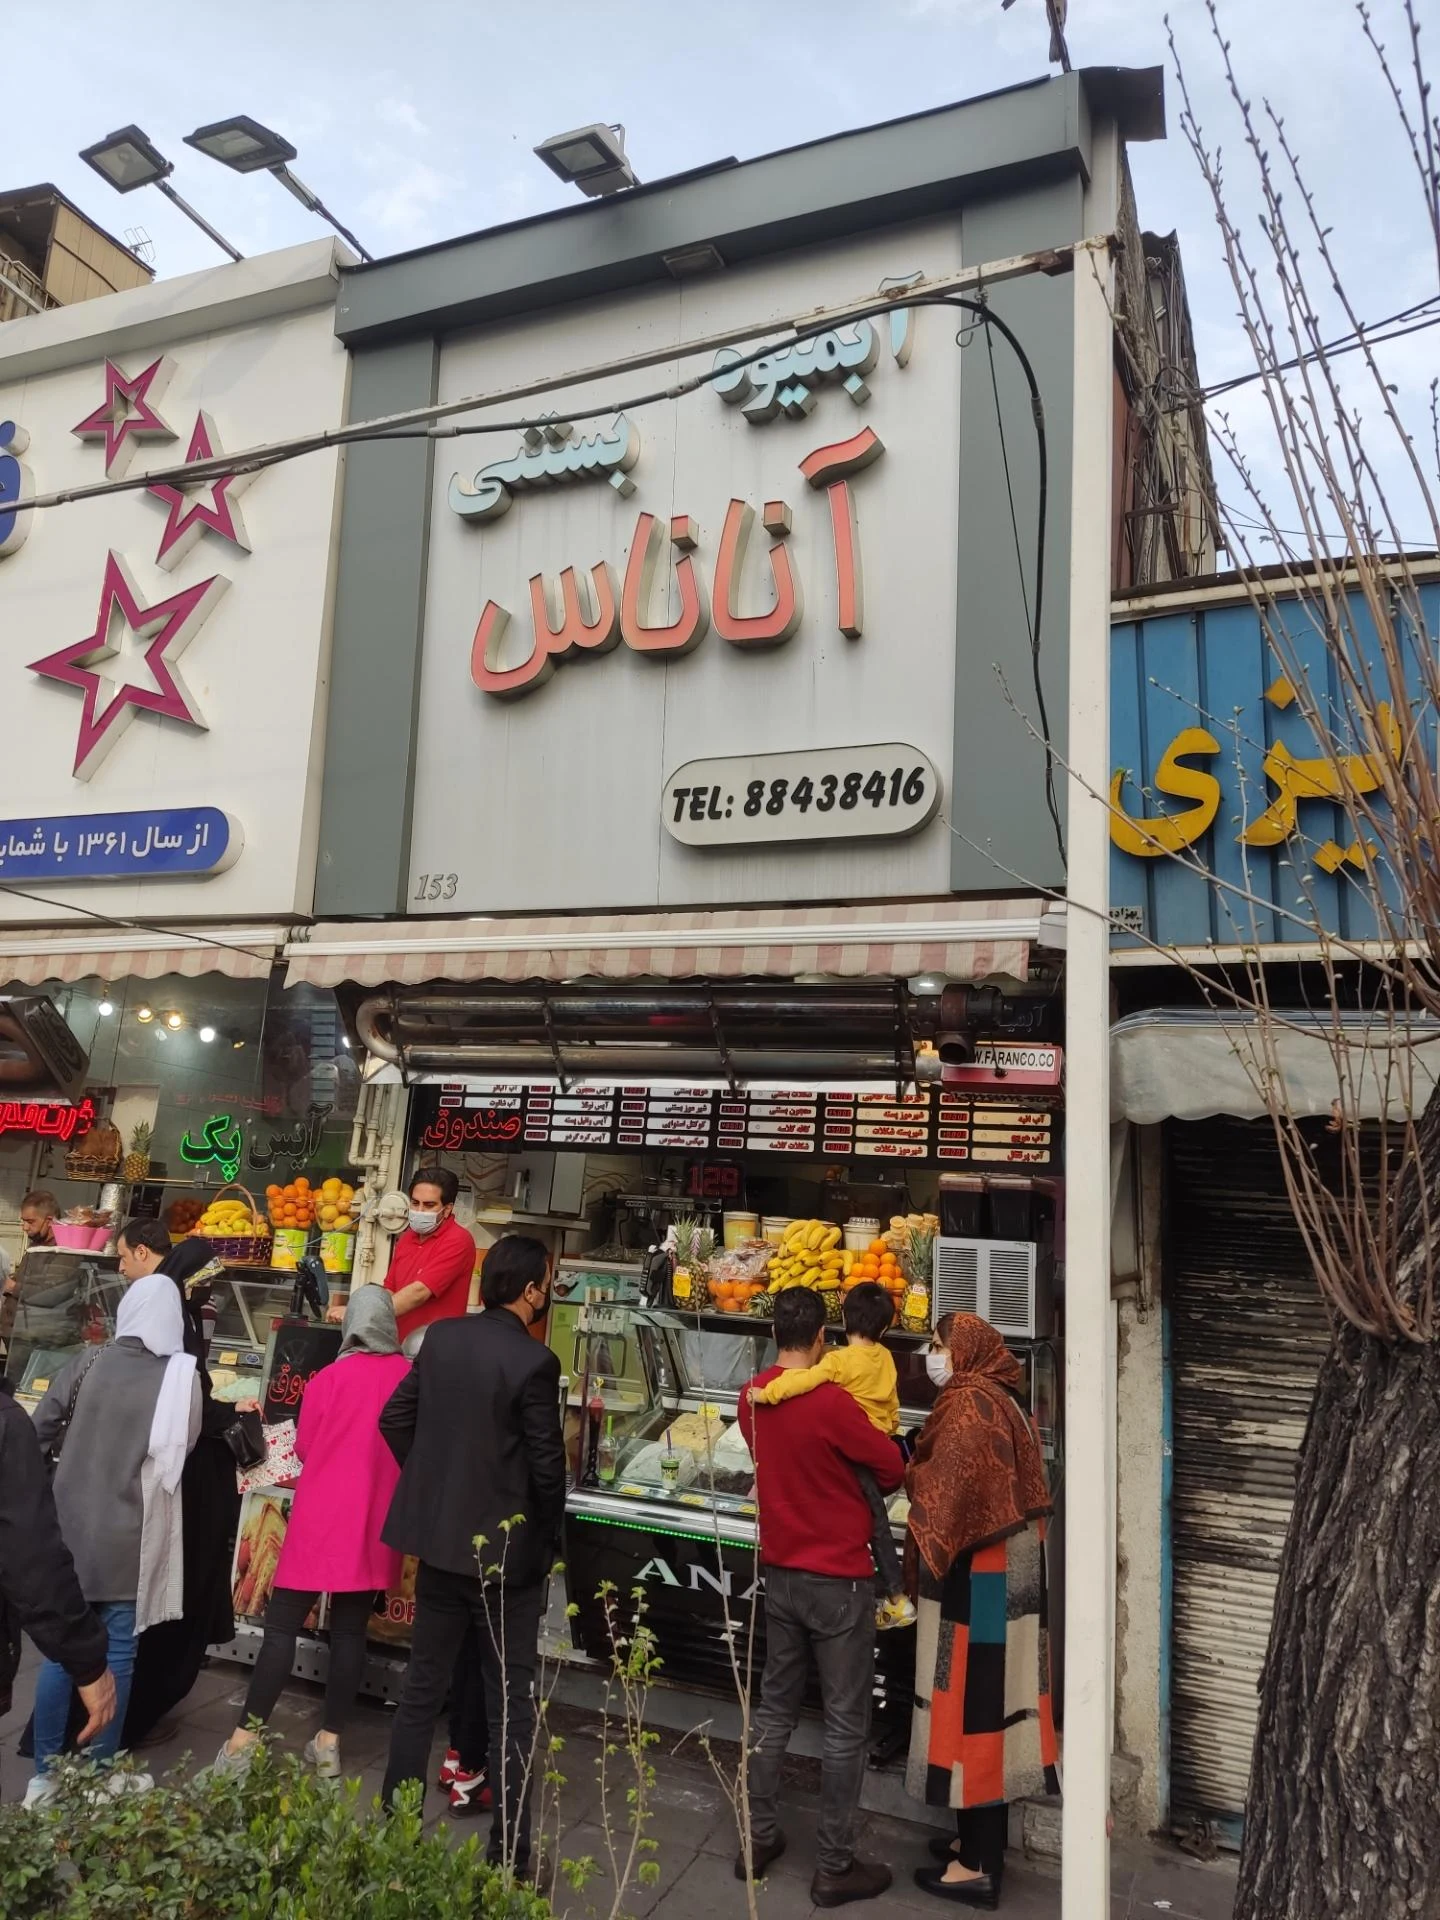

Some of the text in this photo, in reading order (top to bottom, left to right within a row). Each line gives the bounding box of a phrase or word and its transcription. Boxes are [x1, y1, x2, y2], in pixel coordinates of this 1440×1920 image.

[448, 411, 638, 518] بستنی
[471, 426, 885, 695] آناناس
[673, 766, 925, 823] TEL: 88438416
[53, 831, 69, 862] با
[77, 831, 127, 857] ۱۳۶۱
[131, 826, 183, 858] سال
[187, 823, 209, 855] از
[414, 872, 459, 901] 153
[180, 1103, 333, 1183] آیس پک
[423, 1109, 522, 1149] صندوق
